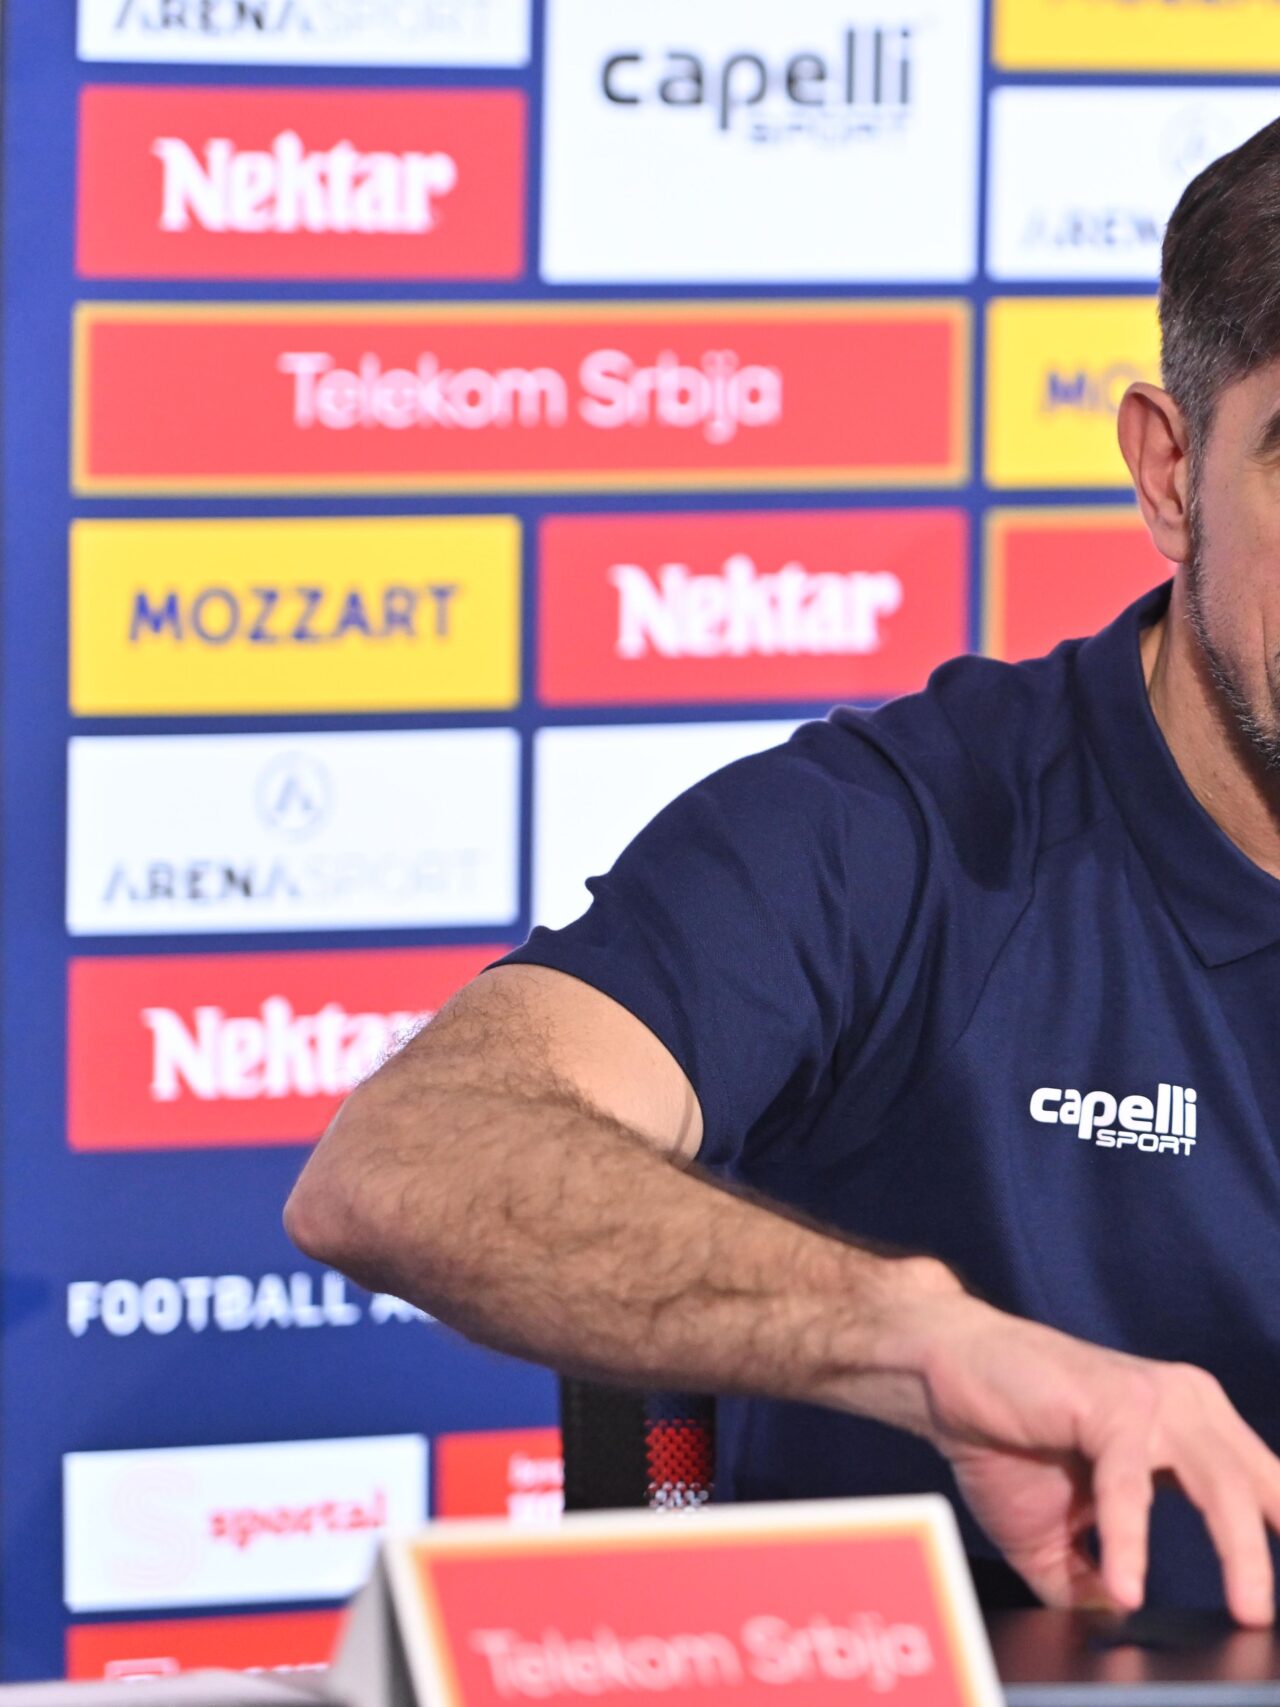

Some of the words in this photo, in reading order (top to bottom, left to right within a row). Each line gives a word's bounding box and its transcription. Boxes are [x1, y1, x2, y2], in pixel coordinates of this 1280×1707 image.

[600, 26, 912, 131] capelli
[150, 131, 457, 235] Nektar
[277, 351, 570, 430] Telekom
[578, 348, 783, 446] Srbija
[128, 584, 460, 645] MOZZART
[608, 552, 902, 660] Nektar
[1029, 1083, 1197, 1141] capelli
[1095, 1128, 1197, 1157] SPORT
[66, 1271, 361, 1338] FOOTBALL
[208, 1488, 388, 1552] sportal
[466, 1622, 744, 1700] Telekom
[738, 1612, 936, 1694] Srbija
